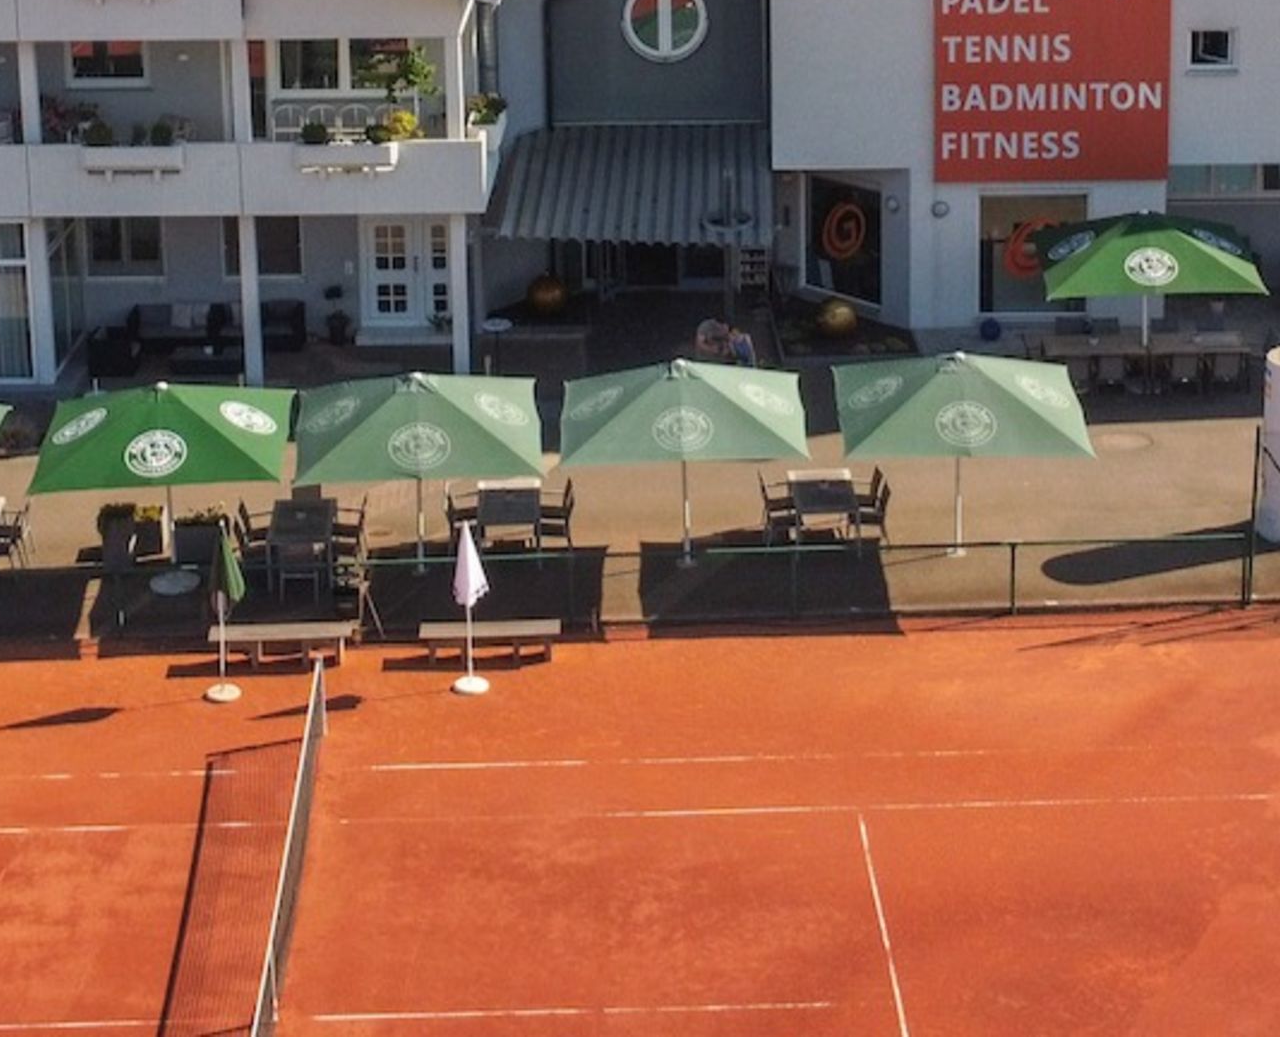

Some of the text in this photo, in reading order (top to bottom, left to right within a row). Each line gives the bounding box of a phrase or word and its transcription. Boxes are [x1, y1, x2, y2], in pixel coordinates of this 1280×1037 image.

[942, 33, 1071, 63] TENNIS
[941, 81, 1162, 112] BADMINTON
[941, 130, 1080, 160] FITNESS
